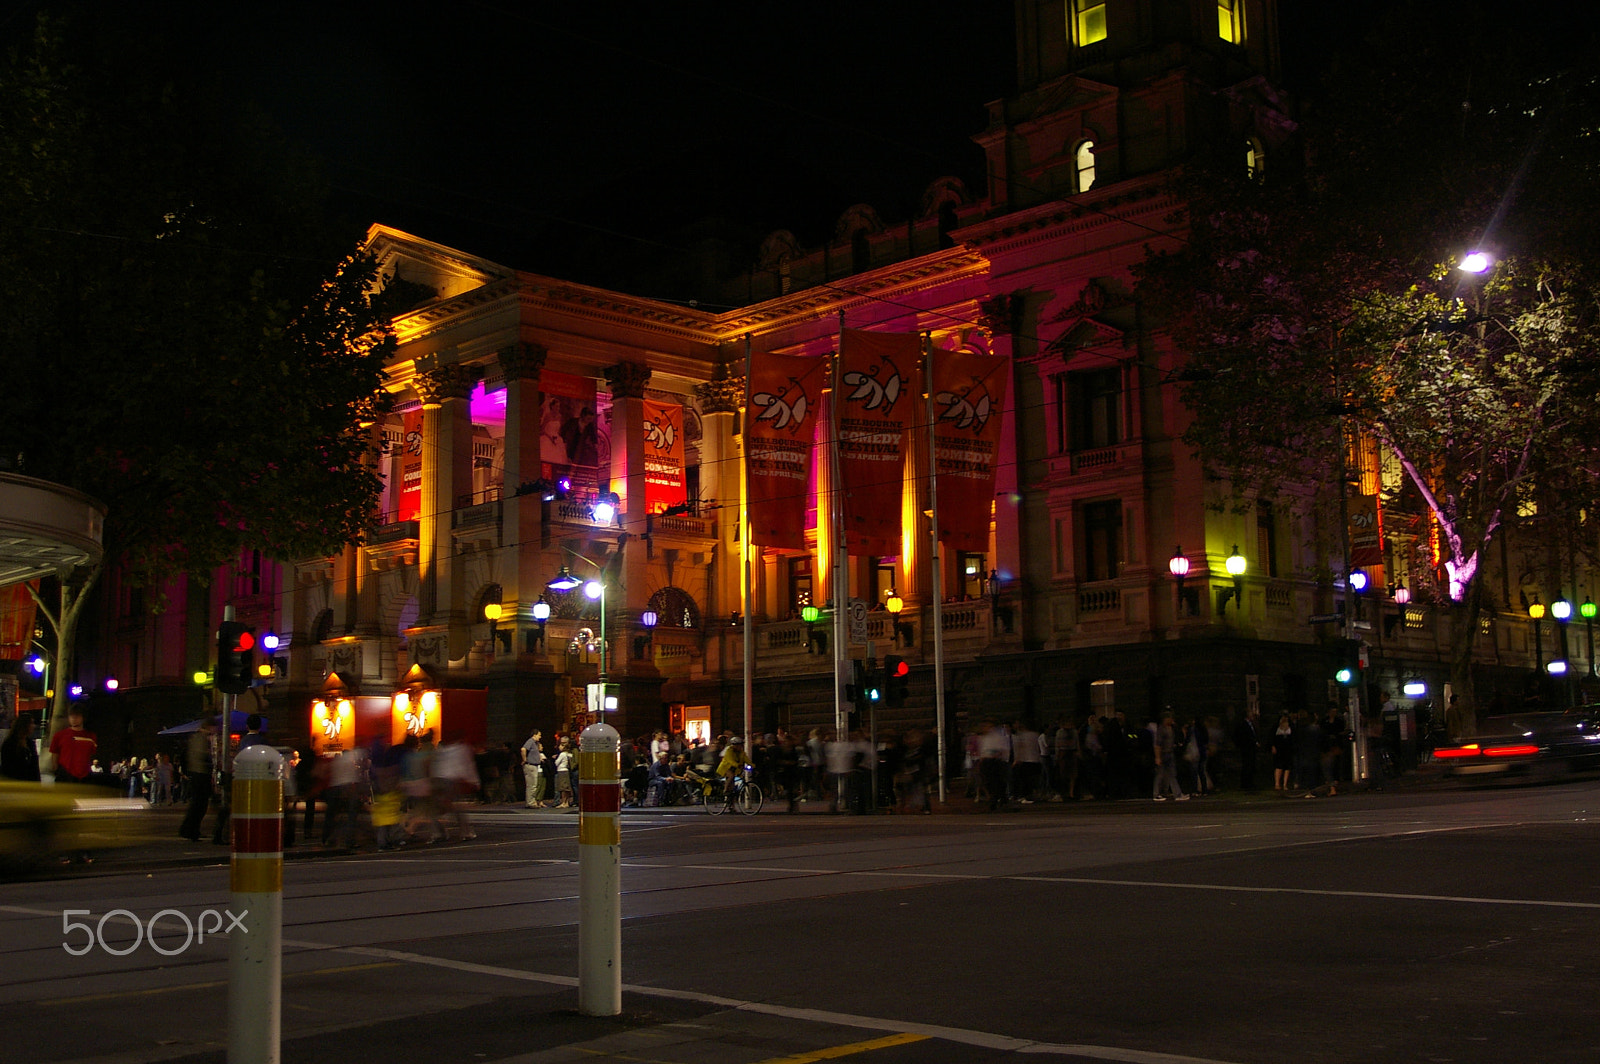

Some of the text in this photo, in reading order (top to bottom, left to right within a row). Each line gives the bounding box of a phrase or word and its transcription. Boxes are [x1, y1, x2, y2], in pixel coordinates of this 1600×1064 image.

[841, 418, 903, 428] MELBOURNE
[839, 430, 902, 445] COMEDY
[840, 439, 900, 453] FESTIVAL
[751, 449, 807, 464] COMEDY
[645, 462, 681, 475] COMEDY
[752, 459, 805, 473] FESTIVAL
